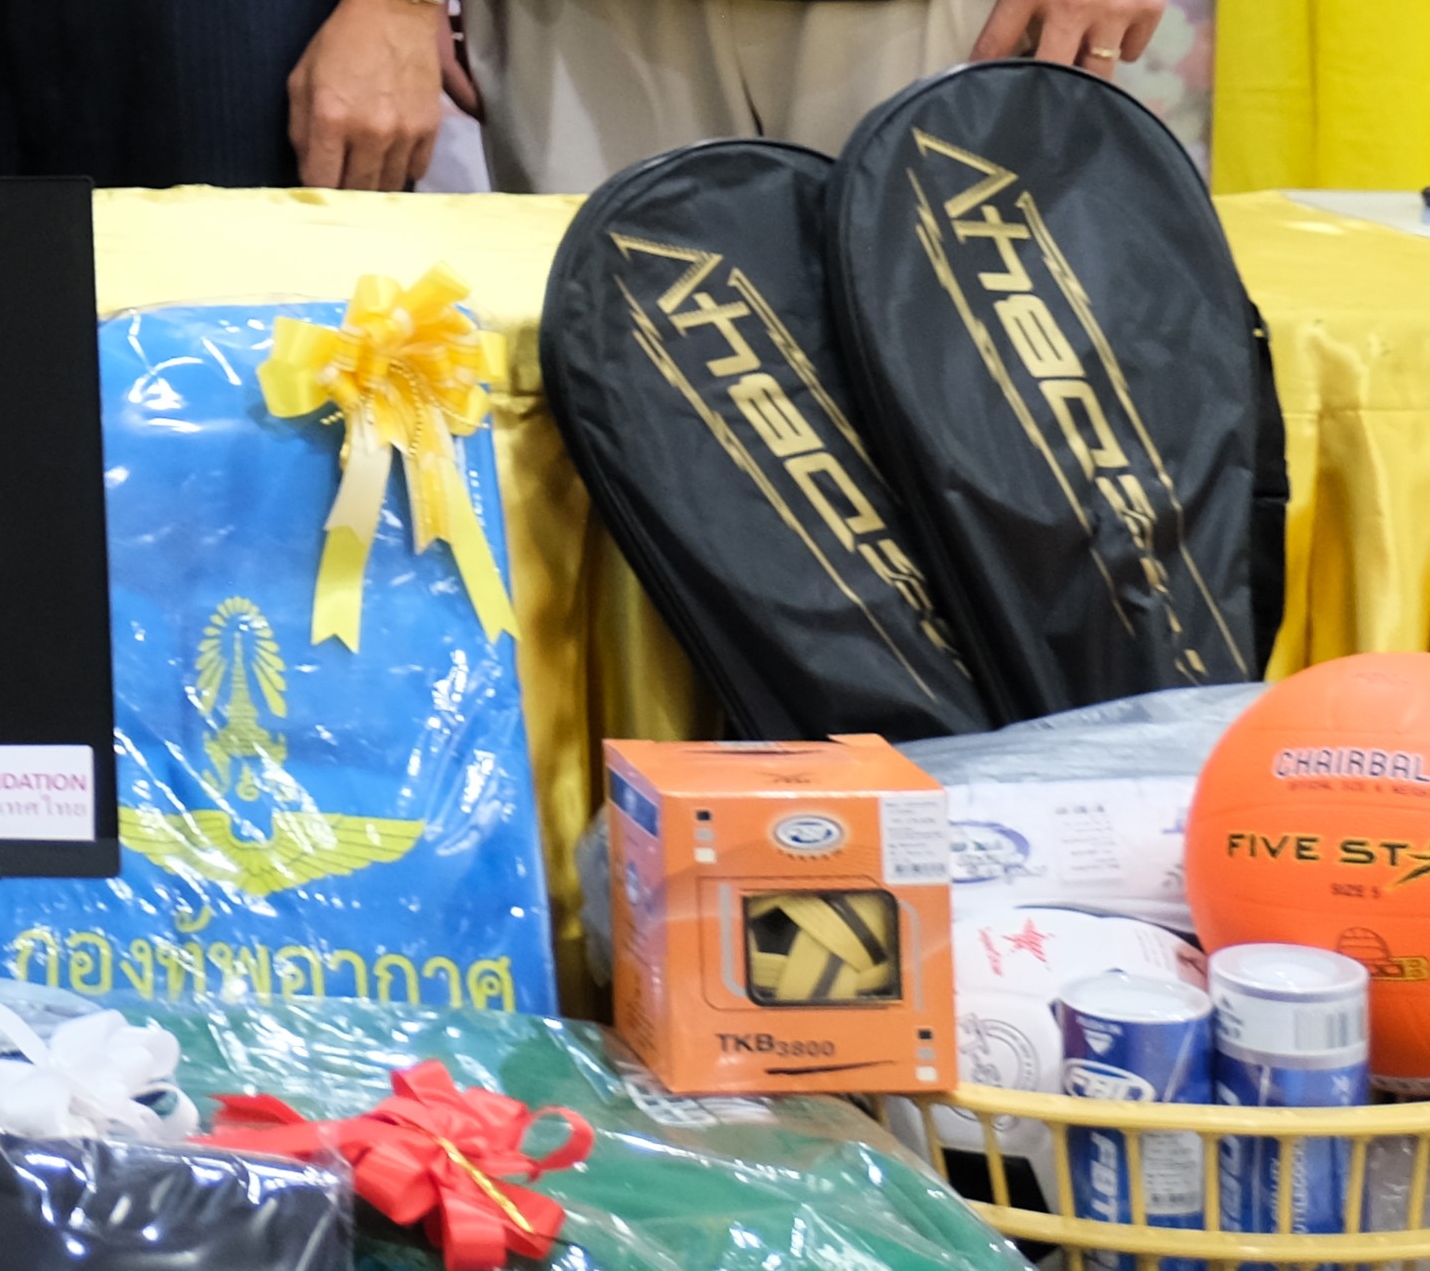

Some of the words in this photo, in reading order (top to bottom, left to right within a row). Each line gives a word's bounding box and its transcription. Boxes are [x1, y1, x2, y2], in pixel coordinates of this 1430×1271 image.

[1275, 748, 1430, 784] CHAIRBAL
[1227, 832, 1321, 861] FIVE
[14, 906, 516, 1013] กองทัพอากาศ
